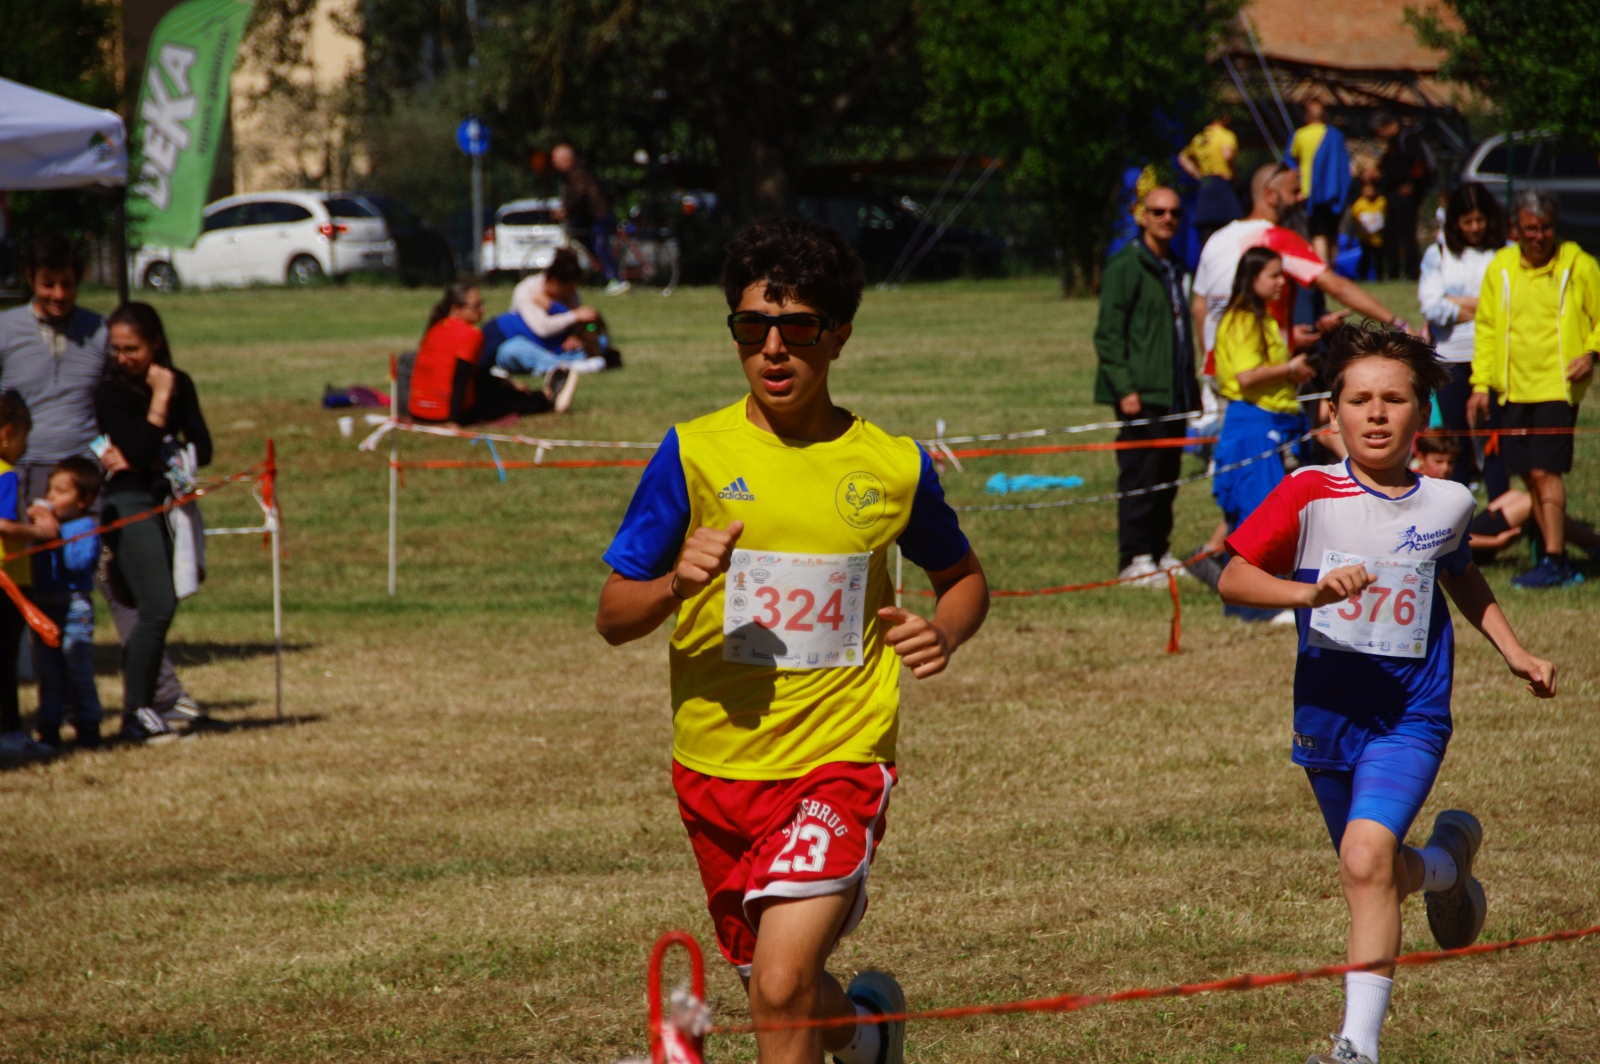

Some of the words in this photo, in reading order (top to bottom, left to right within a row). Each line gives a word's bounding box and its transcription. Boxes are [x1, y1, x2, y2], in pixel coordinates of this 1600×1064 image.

[717, 491, 755, 502] adidas
[1416, 527, 1452, 542] Atletica
[752, 586, 845, 632] 324
[1337, 586, 1416, 626] 376
[768, 823, 831, 873] 23
